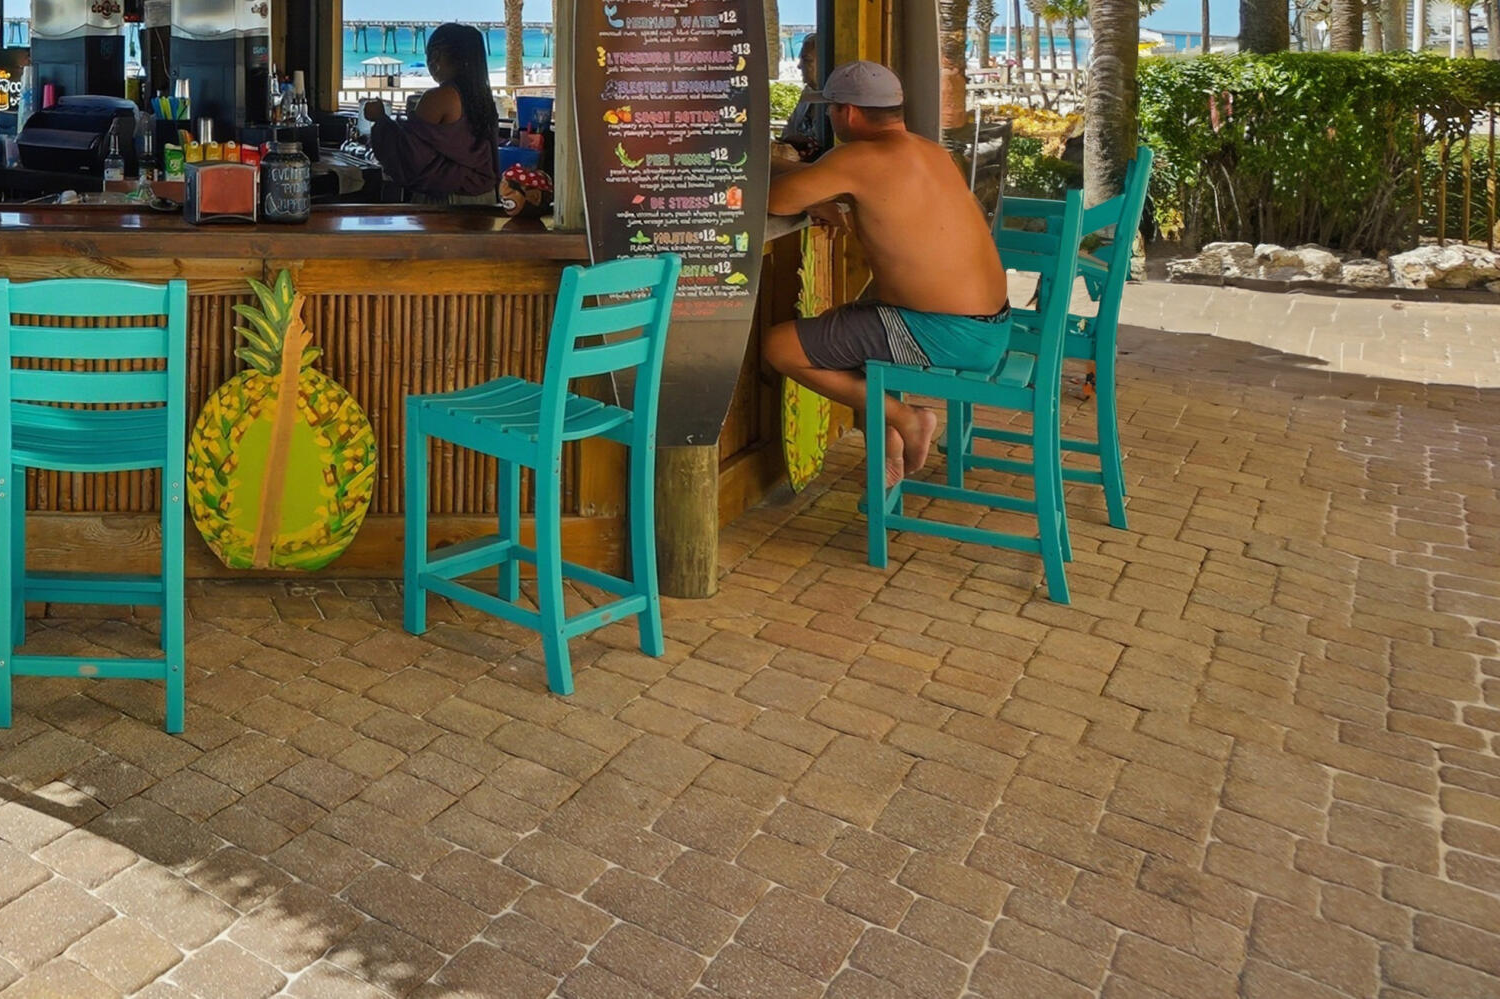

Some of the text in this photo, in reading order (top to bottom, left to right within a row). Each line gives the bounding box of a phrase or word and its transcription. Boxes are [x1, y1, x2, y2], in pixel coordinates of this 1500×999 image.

[626, 10, 737, 29] MERMAID WATER $12
[674, 50, 734, 63] LEMONADE
[732, 42, 751, 55] $13
[616, 75, 749, 93] ELECTRIC LEMONADE $13
[719, 105, 737, 119] $12
[645, 147, 729, 167] PIER PUNCH $12
[650, 191, 727, 210] DE STRESS $12
[653, 228, 717, 245] MOJITOS $12
[713, 261, 732, 274] $12
